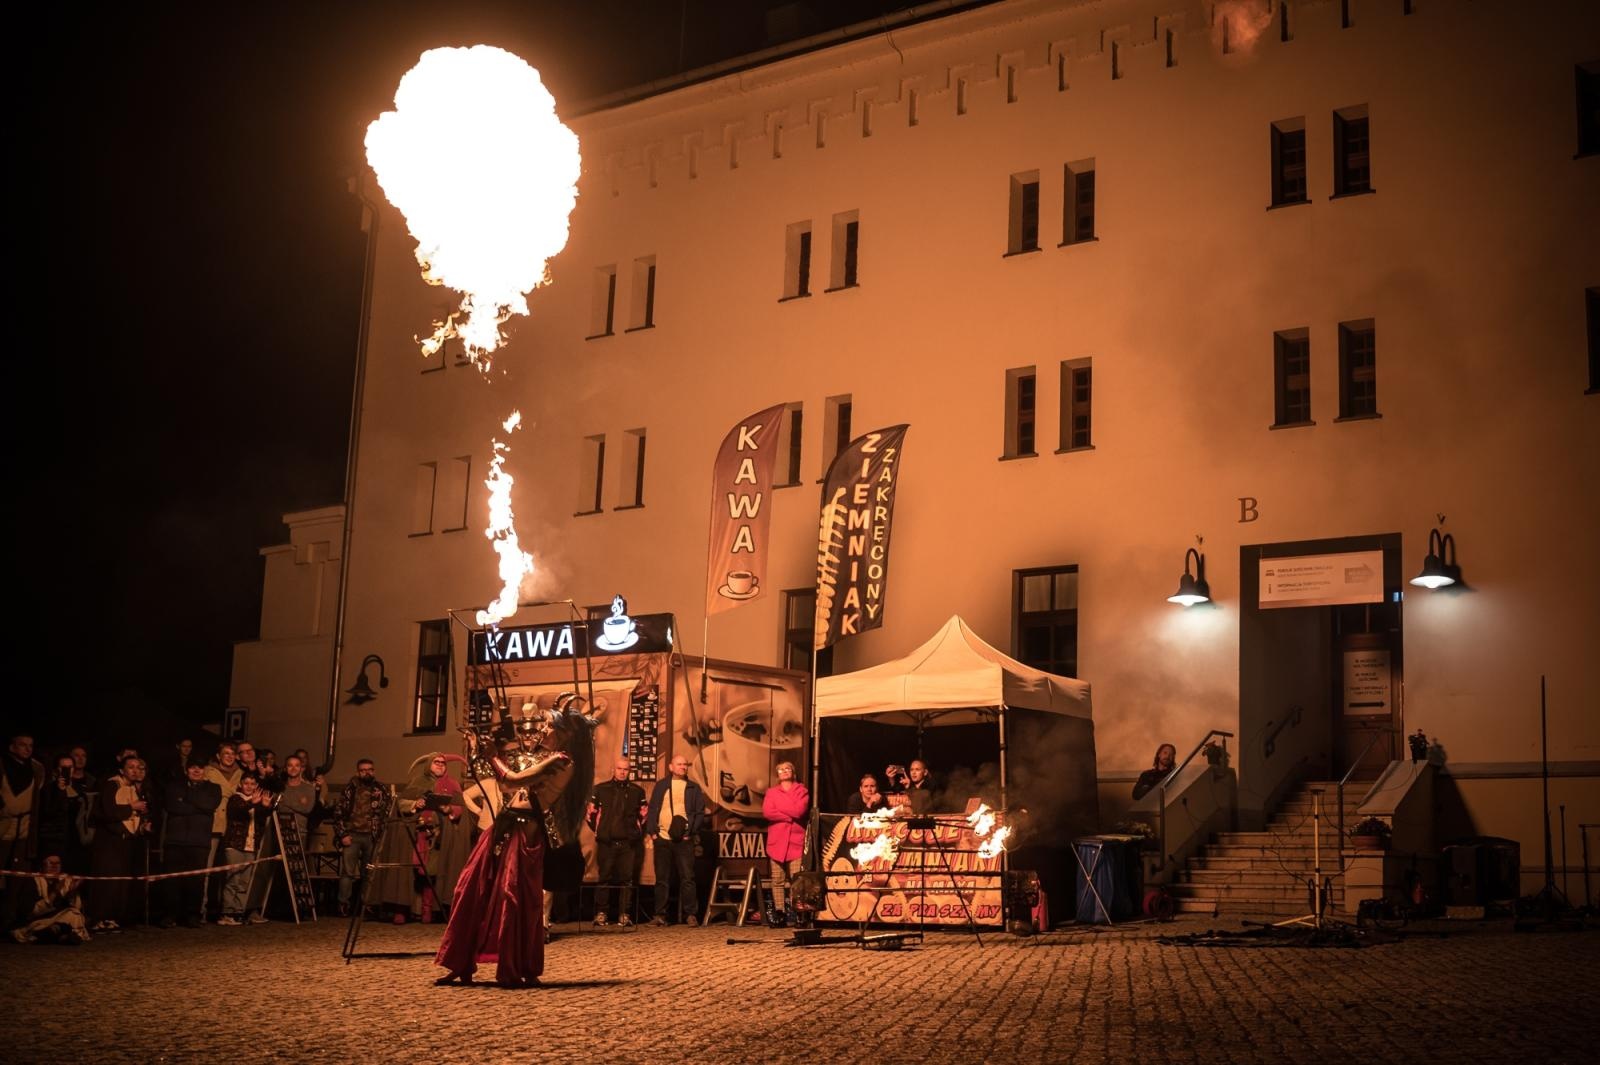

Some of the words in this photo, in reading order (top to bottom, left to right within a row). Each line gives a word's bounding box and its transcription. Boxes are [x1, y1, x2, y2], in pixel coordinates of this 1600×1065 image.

[727, 424, 763, 554] KAWA
[1238, 497, 1259, 523] B
[841, 433, 882, 634] ZIEMNIAK
[865, 448, 895, 618] ZAKRĘCONY
[485, 626, 575, 661] KAWA
[230, 713, 242, 737] P
[718, 832, 767, 858] KAWA
